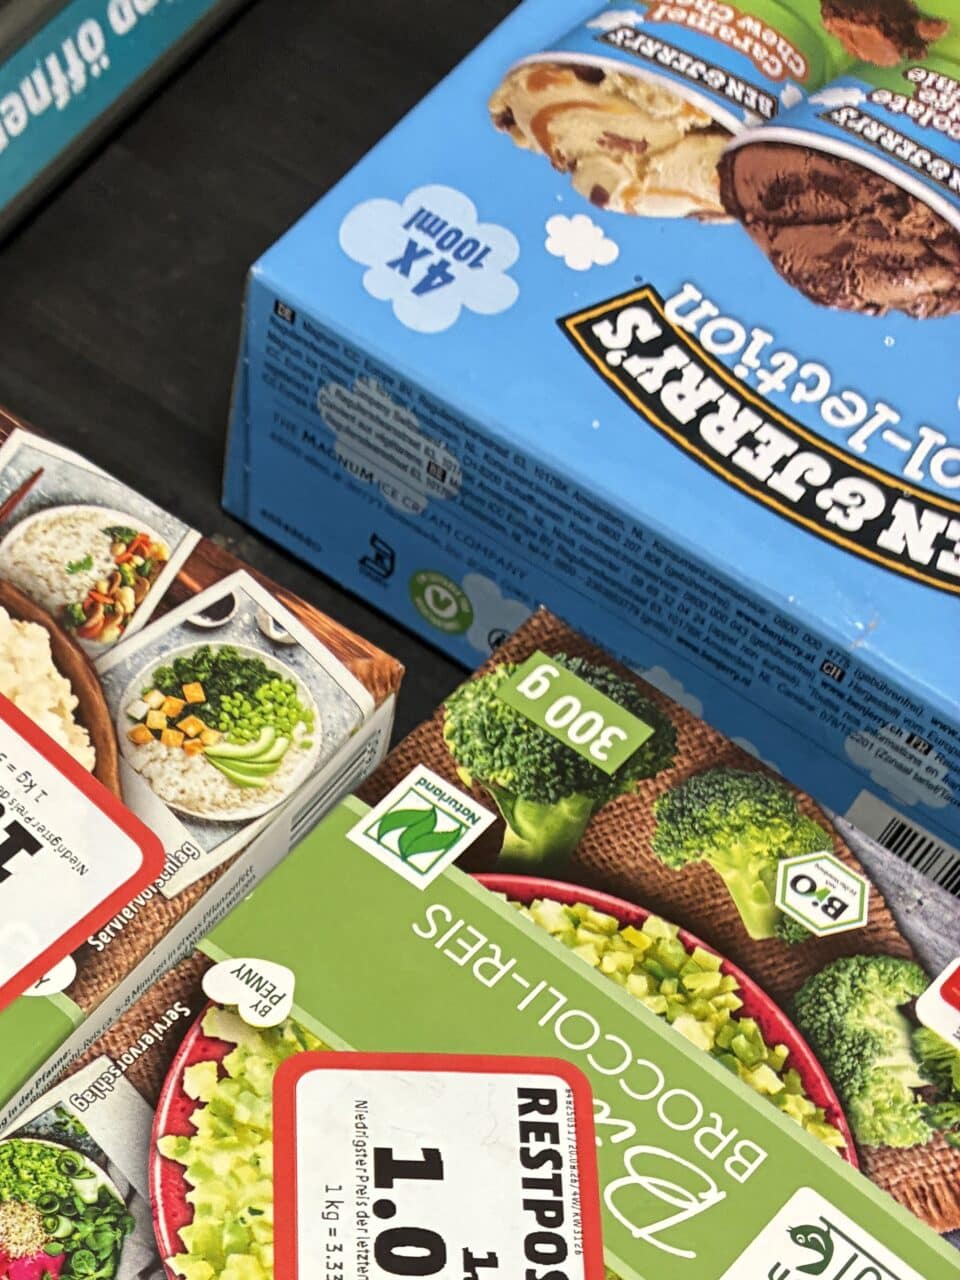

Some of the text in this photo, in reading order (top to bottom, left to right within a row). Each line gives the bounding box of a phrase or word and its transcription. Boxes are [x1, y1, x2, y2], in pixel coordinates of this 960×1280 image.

[652, 5, 784, 78] Caramel
[737, 16, 806, 78] Chew
[725, 80, 776, 118] BEN
[402, 206, 492, 269] 100ml
[386, 238, 456, 297] 4X
[664, 283, 960, 490] ol-lection
[299, 428, 376, 485] MAGNUM
[592, 307, 960, 578] EN & JERRY'S
[516, 664, 630, 763] 300 g
[11, 767, 40, 795] kg
[415, 776, 483, 827] Naturland
[231, 963, 287, 1006] PENNY
[249, 1001, 272, 1018] BY
[70, 1001, 192, 1112] Serviervorschlag
[412, 904, 769, 1183] BROCCOLI-REIS
[321, 1199, 340, 1222] kg
[325, 1184, 343, 1194] 1
